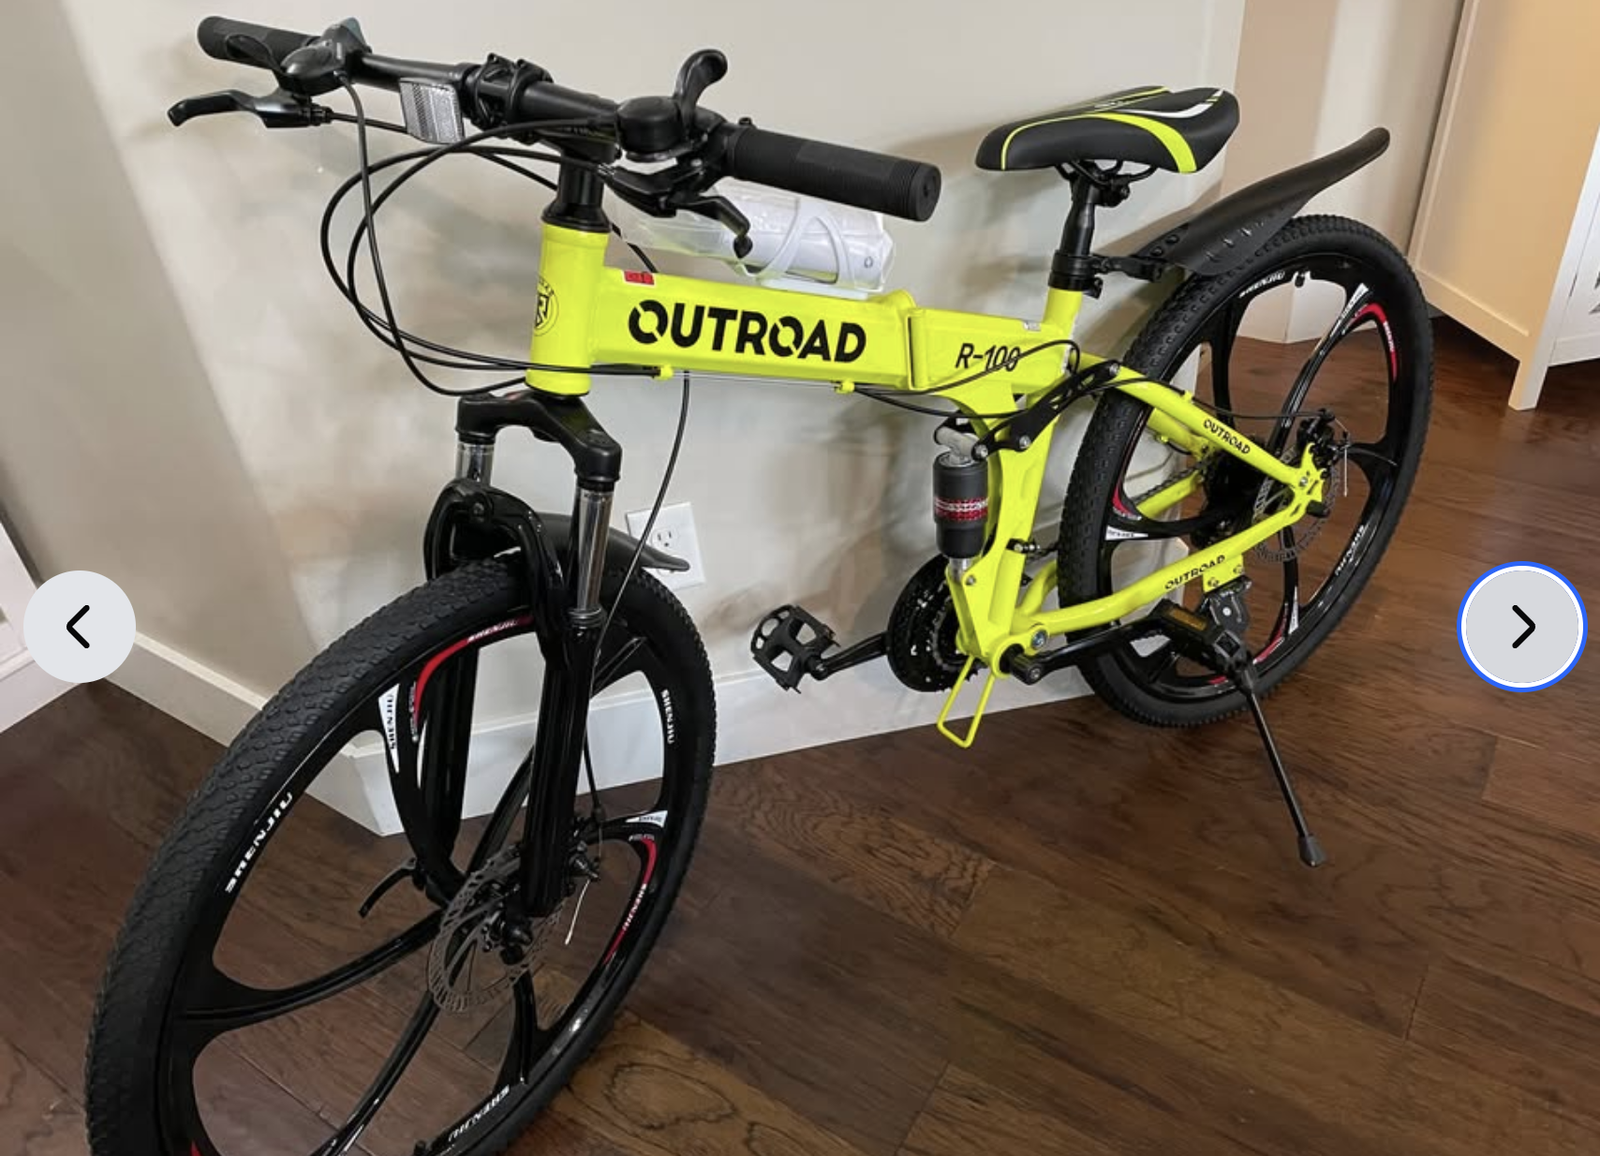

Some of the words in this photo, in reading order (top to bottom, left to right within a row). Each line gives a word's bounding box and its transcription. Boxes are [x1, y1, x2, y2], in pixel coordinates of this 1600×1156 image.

[628, 299, 867, 363] OUTROAD
[955, 342, 1021, 372] R-100
[1203, 419, 1250, 454] OUTROAD
[1165, 554, 1225, 590] OUTROAD
